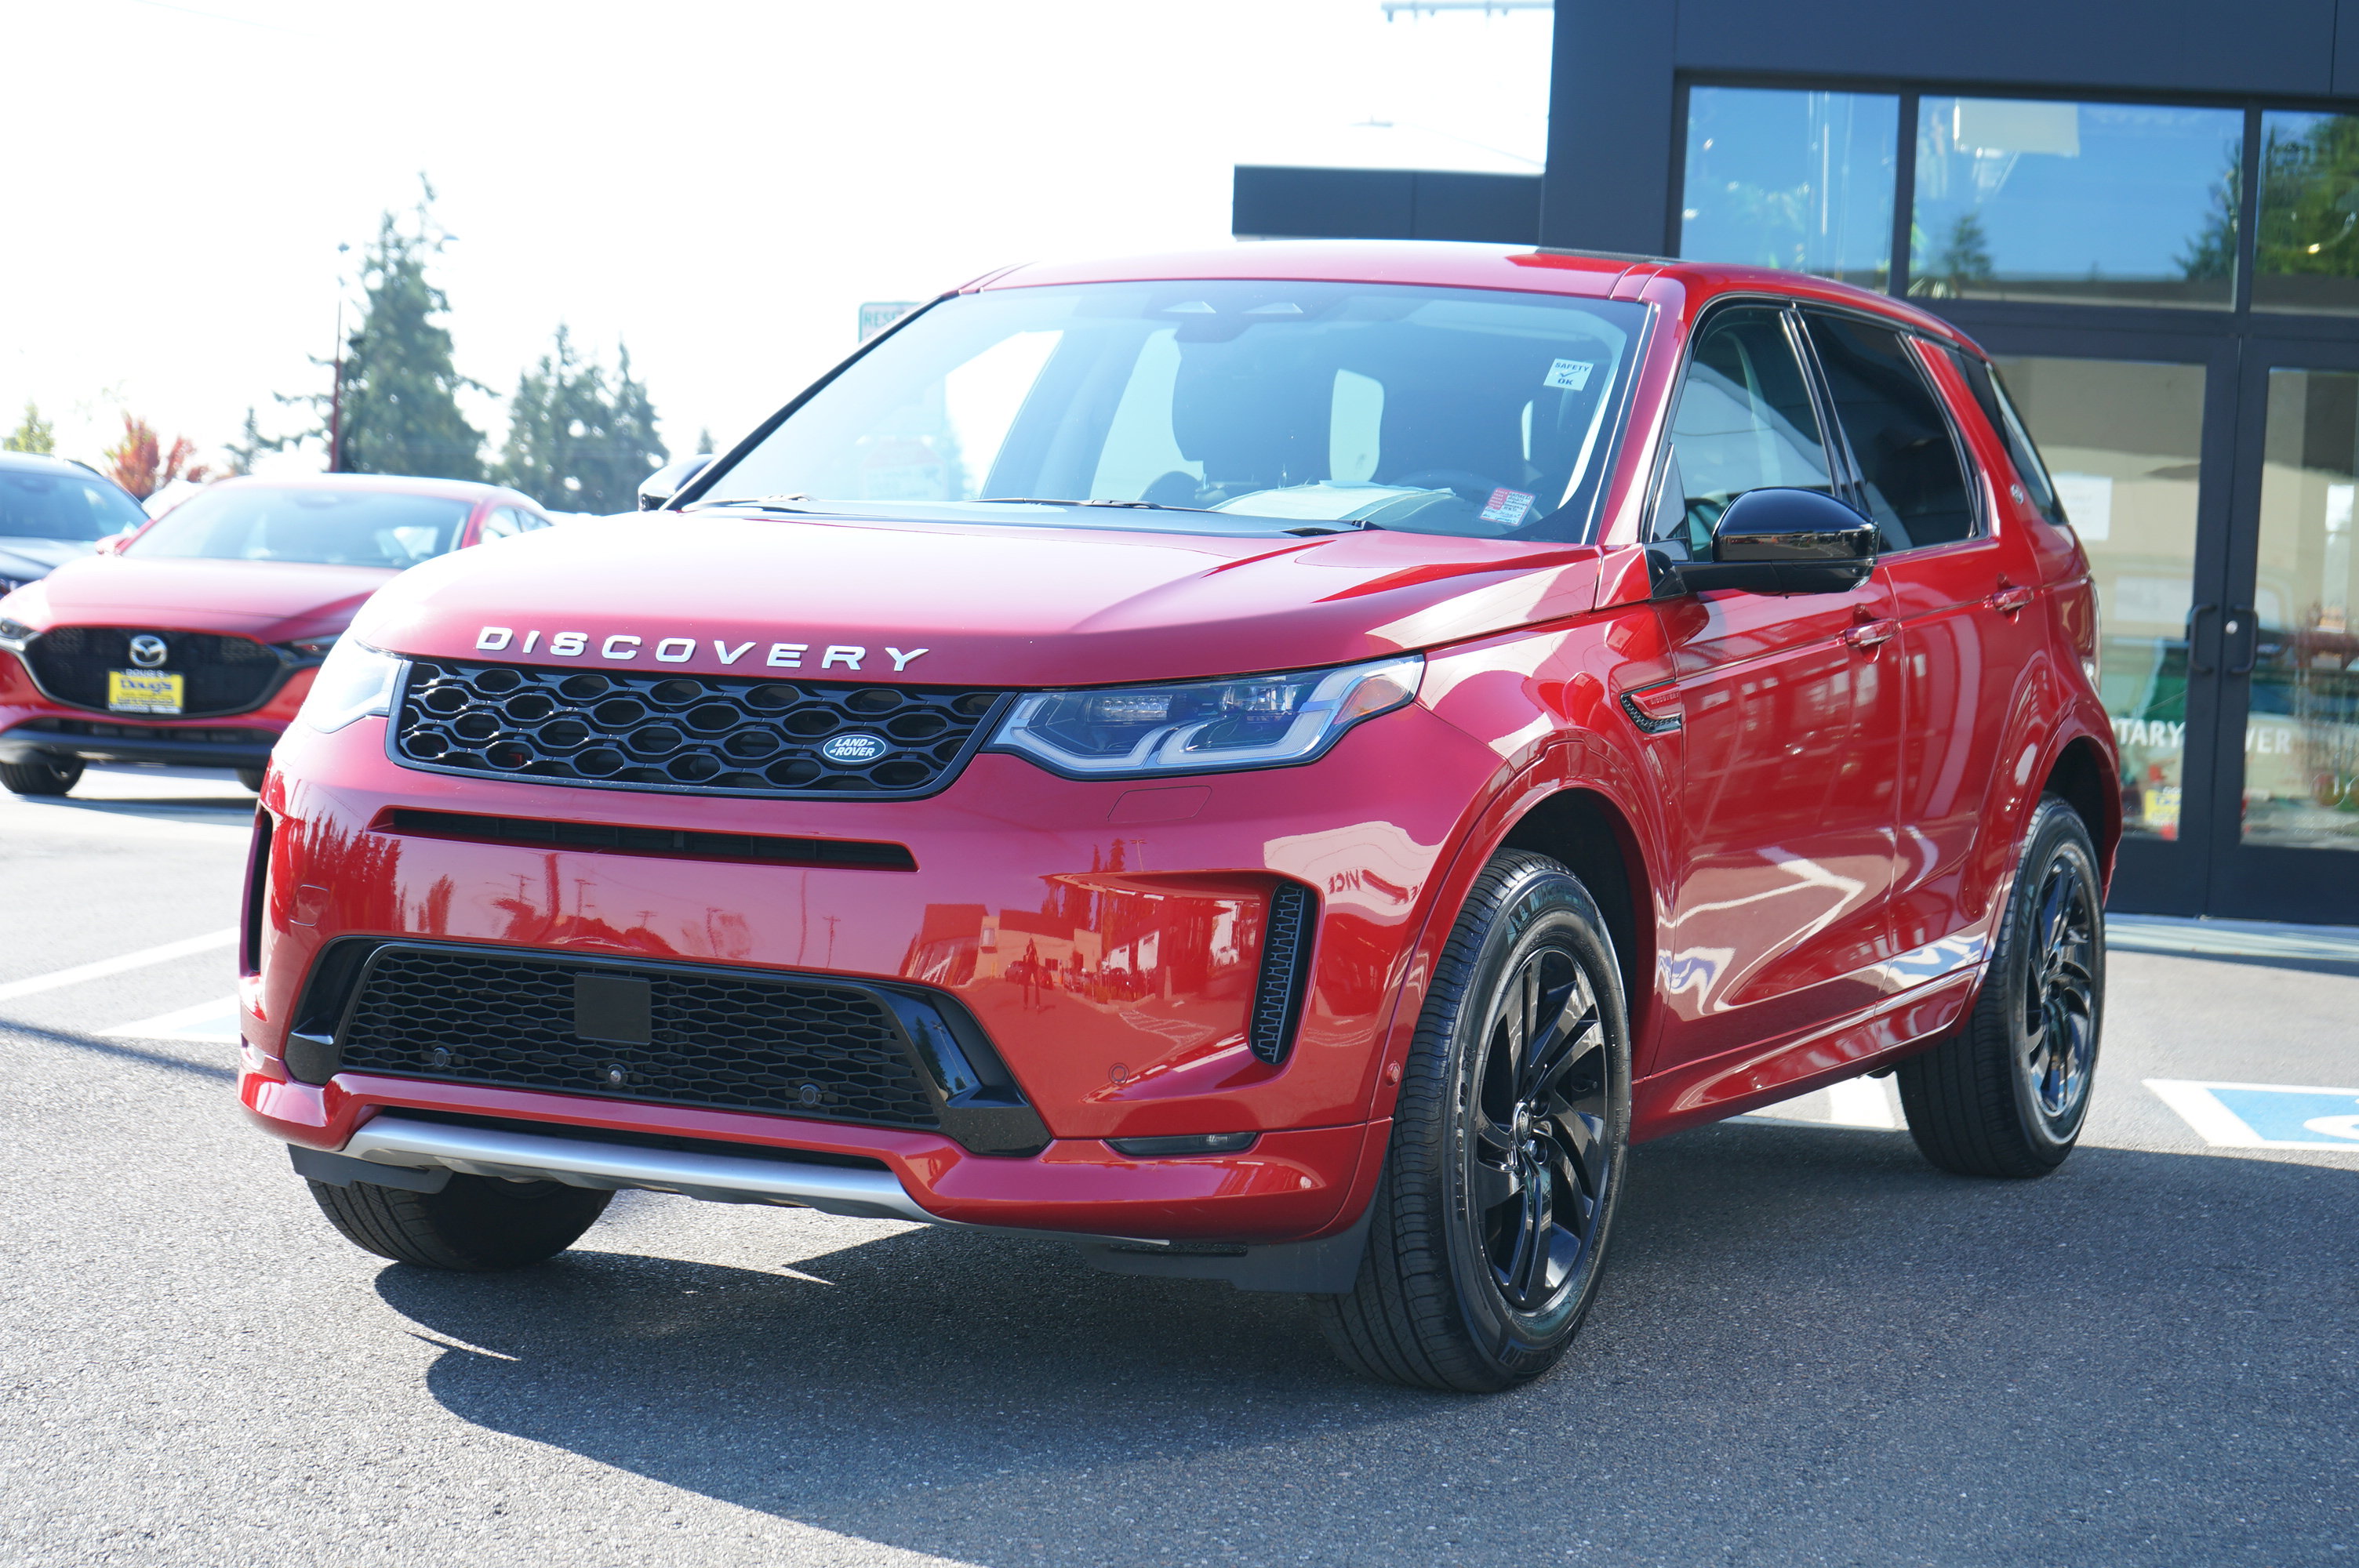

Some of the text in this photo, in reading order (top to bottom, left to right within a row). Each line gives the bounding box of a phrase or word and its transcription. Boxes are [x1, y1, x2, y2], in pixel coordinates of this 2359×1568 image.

[1555, 362, 1590, 372] SAFETY
[476, 626, 929, 672] DISCOVERY
[2110, 717, 2186, 748] TARY
[834, 738, 868, 747] LAND
[834, 747, 875, 757] ROVER
